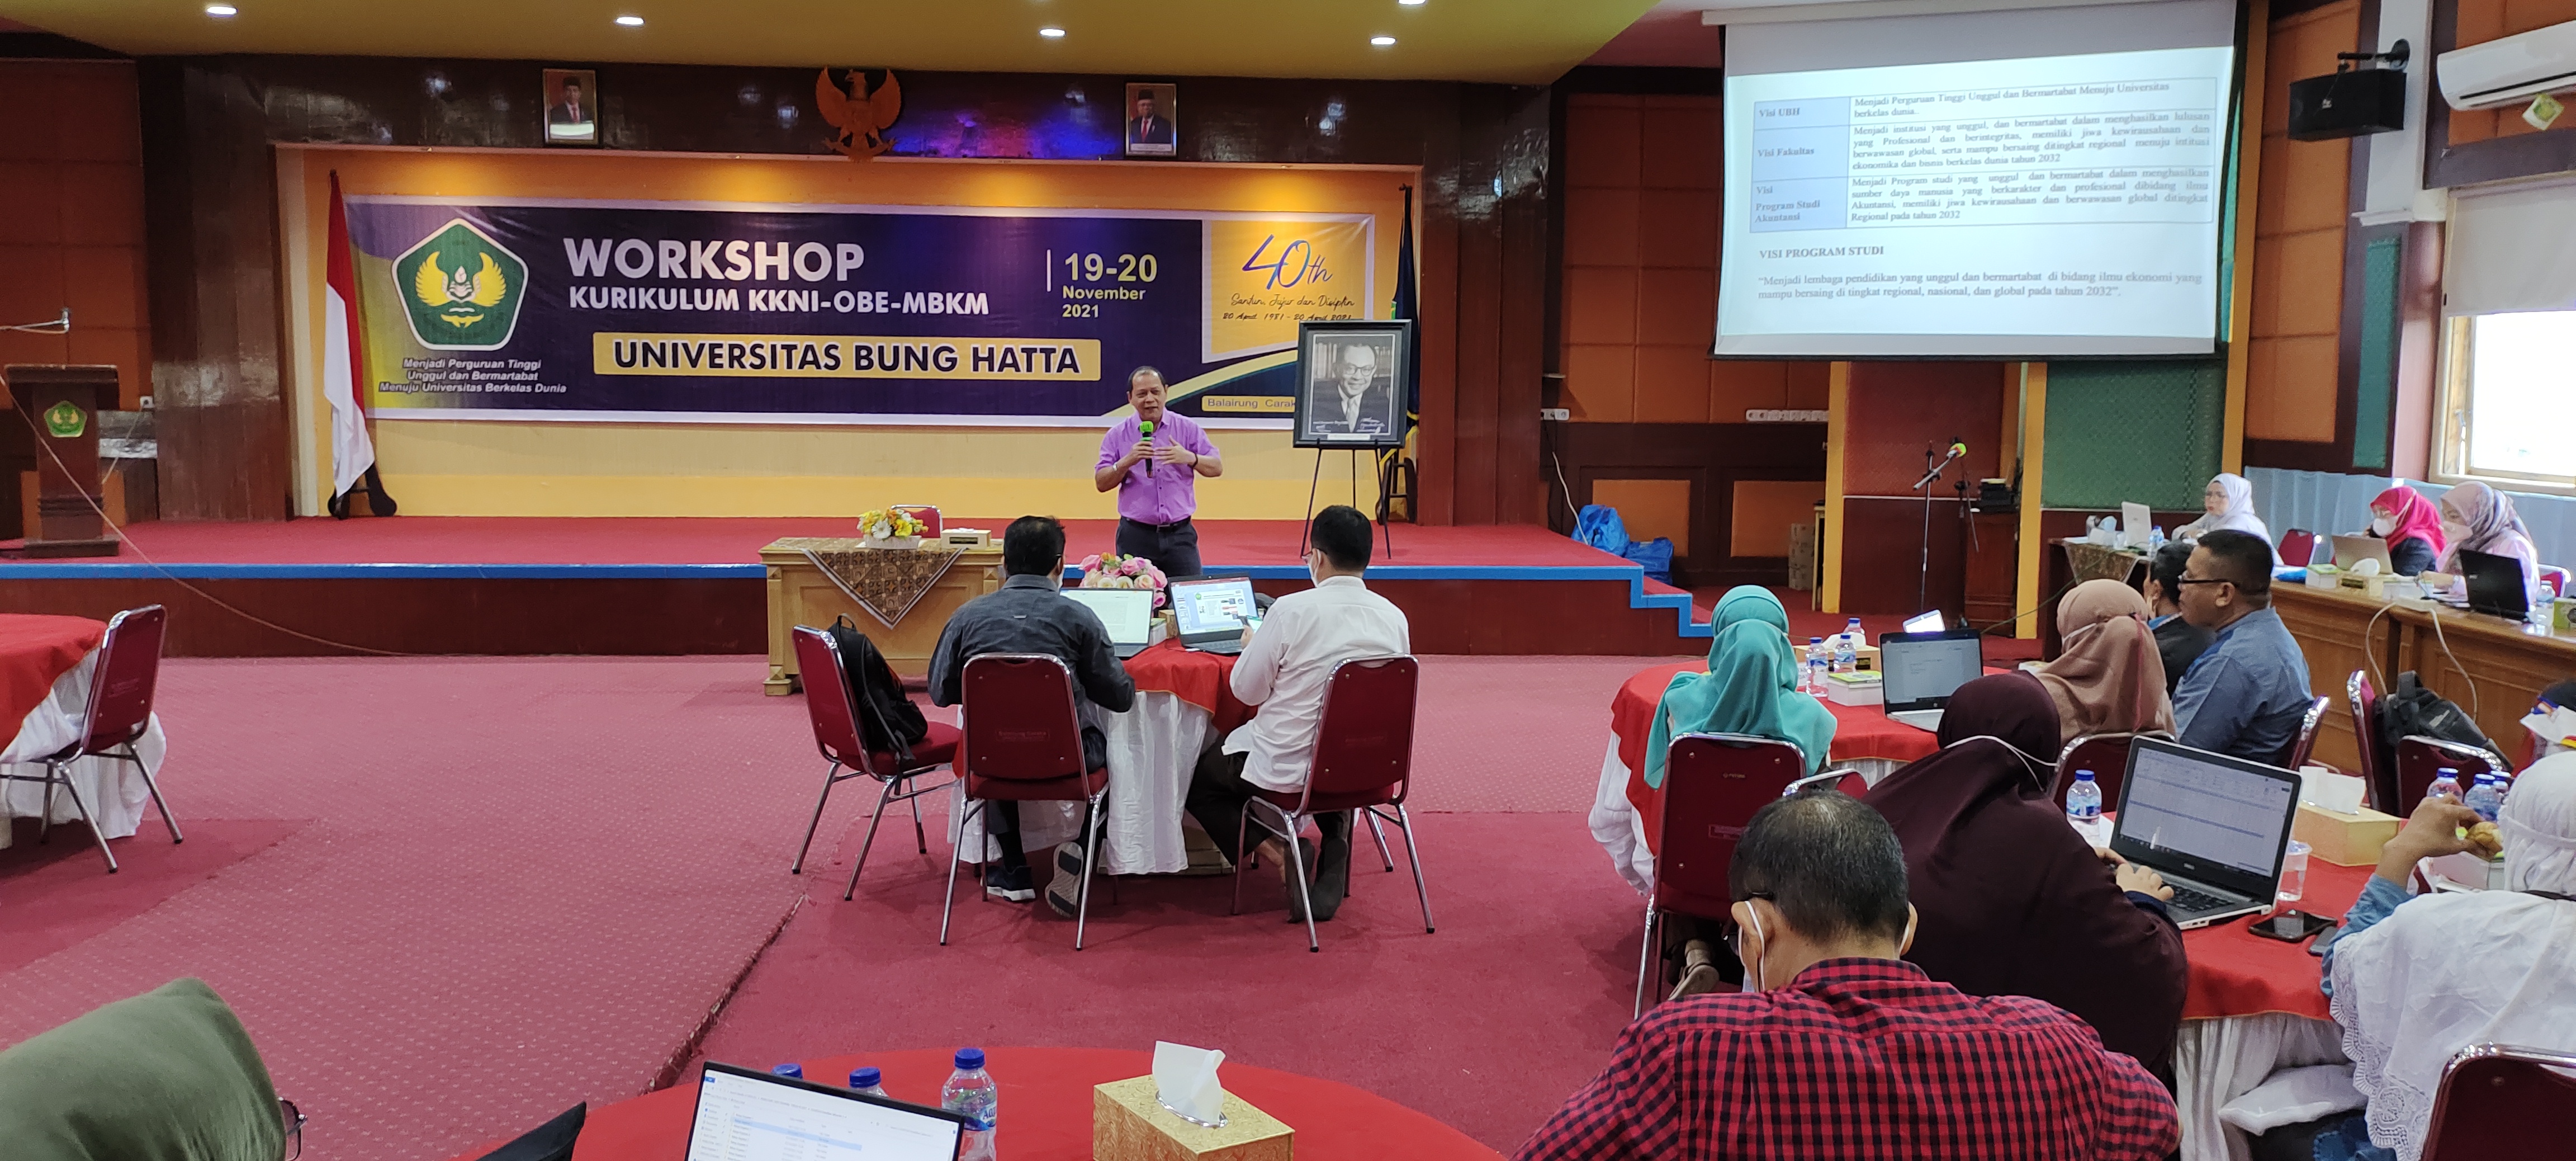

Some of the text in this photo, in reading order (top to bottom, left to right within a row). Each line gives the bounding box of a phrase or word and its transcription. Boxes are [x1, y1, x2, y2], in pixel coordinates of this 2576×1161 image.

[1855, 82, 2170, 108] Menjadi Perguruan Tinggi Unggul dan Bermartabat Menuju Universitas
[1854, 109, 1889, 117] berkelas
[1854, 126, 1888, 136] Menjadi
[1931, 125, 1951, 134] yang
[1957, 121, 1988, 131] unggul,
[1994, 120, 2009, 129] dan
[2015, 117, 2067, 128] bermartabat
[2072, 116, 2100, 125] dalam
[2105, 113, 2169, 125] menghasilkan
[2175, 112, 2209, 121] lulusan
[1853, 139, 1873, 149] yang
[1883, 136, 1930, 145] Profesional
[2032, 129, 2072, 138] memiliki
[2081, 129, 2101, 139] jiwa
[2111, 126, 2181, 136] kewirausahaan
[2192, 125, 2209, 134] dan
[1777, 148, 1815, 156] Fakultas
[1853, 148, 1904, 157] berwawasan
[1967, 145, 1997, 154] mampu
[2002, 142, 2039, 153] bersaing
[2044, 140, 2084, 150] ditingkat
[2089, 138, 2125, 149] regional
[2135, 138, 2170, 148] menuju
[1852, 161, 1898, 169] ekonomika
[1919, 158, 1943, 167] bisnis
[1946, 157, 1982, 166] berkelas
[1984, 155, 2009, 164] dunia
[2011, 154, 2035, 163] tahun
[2038, 154, 2061, 162] 2032
[1852, 168, 2209, 187] Menjadi Program studi yang unggul dan bermartabat dalam menghasilkan
[1852, 190, 1882, 198] sumber
[1890, 188, 1910, 198] daya
[1962, 187, 1982, 197] yang
[1991, 185, 2041, 194] berkarakter
[2050, 183, 2066, 192] dan
[2075, 182, 2125, 193] profesional
[2135, 181, 2176, 191] dibidang
[2186, 181, 2208, 190] ilmu
[1755, 200, 1820, 211] Program Studi
[1851, 193, 2207, 209] Akuntansi, memiliki jiwa kewirausahaan dan berwawasan global ditingkat
[1755, 213, 1800, 223] Akuntansi
[1851, 212, 1888, 221] Regional
[1890, 211, 1910, 221] pada
[1939, 210, 1960, 219] 2032
[564, 238, 864, 281] WORKSHOP
[1759, 246, 1883, 258] VISI PROGRAM STUDI
[1064, 253, 1157, 284] 19-20
[1242, 234, 1333, 290] 40th
[1804, 274, 1843, 285] lembaga
[1845, 273, 1897, 285] pendidikan
[1900, 274, 1923, 284] yang
[1926, 272, 1959, 284] unggul
[1962, 272, 1979, 280] dan
[1983, 272, 2042, 281] bermartabat
[2048, 272, 2058, 281] di
[2061, 271, 2096, 284] bidang
[2099, 271, 2123, 281] ilmu
[2125, 272, 2172, 282] ekonomi
[2175, 274, 2202, 285] yang
[570, 286, 989, 315] KURIKULUM KKNI-OBE-MBKM
[1062, 285, 1145, 301] November
[1759, 291, 1792, 300] mampu
[1795, 289, 1834, 299] bersaing
[1848, 288, 1880, 298] tingkat
[1883, 287, 1924, 298] regional,
[1928, 287, 1971, 296] nasional,
[1974, 286, 1991, 295] dan
[1994, 286, 2025, 297] global
[2028, 286, 2052, 297] pada
[2055, 286, 2083, 296] tahun
[1062, 304, 1099, 318] 2021
[403, 358, 541, 371] Menjadi Perguruan Tinggi
[614, 341, 1081, 374] UNIVERSITAS BUNG HATTA
[408, 371, 538, 381] Unggul dan Bermartabat
[380, 383, 567, 393] Menuju Universitas Berkelas Dunia
[1208, 398, 1258, 409] Balairung
